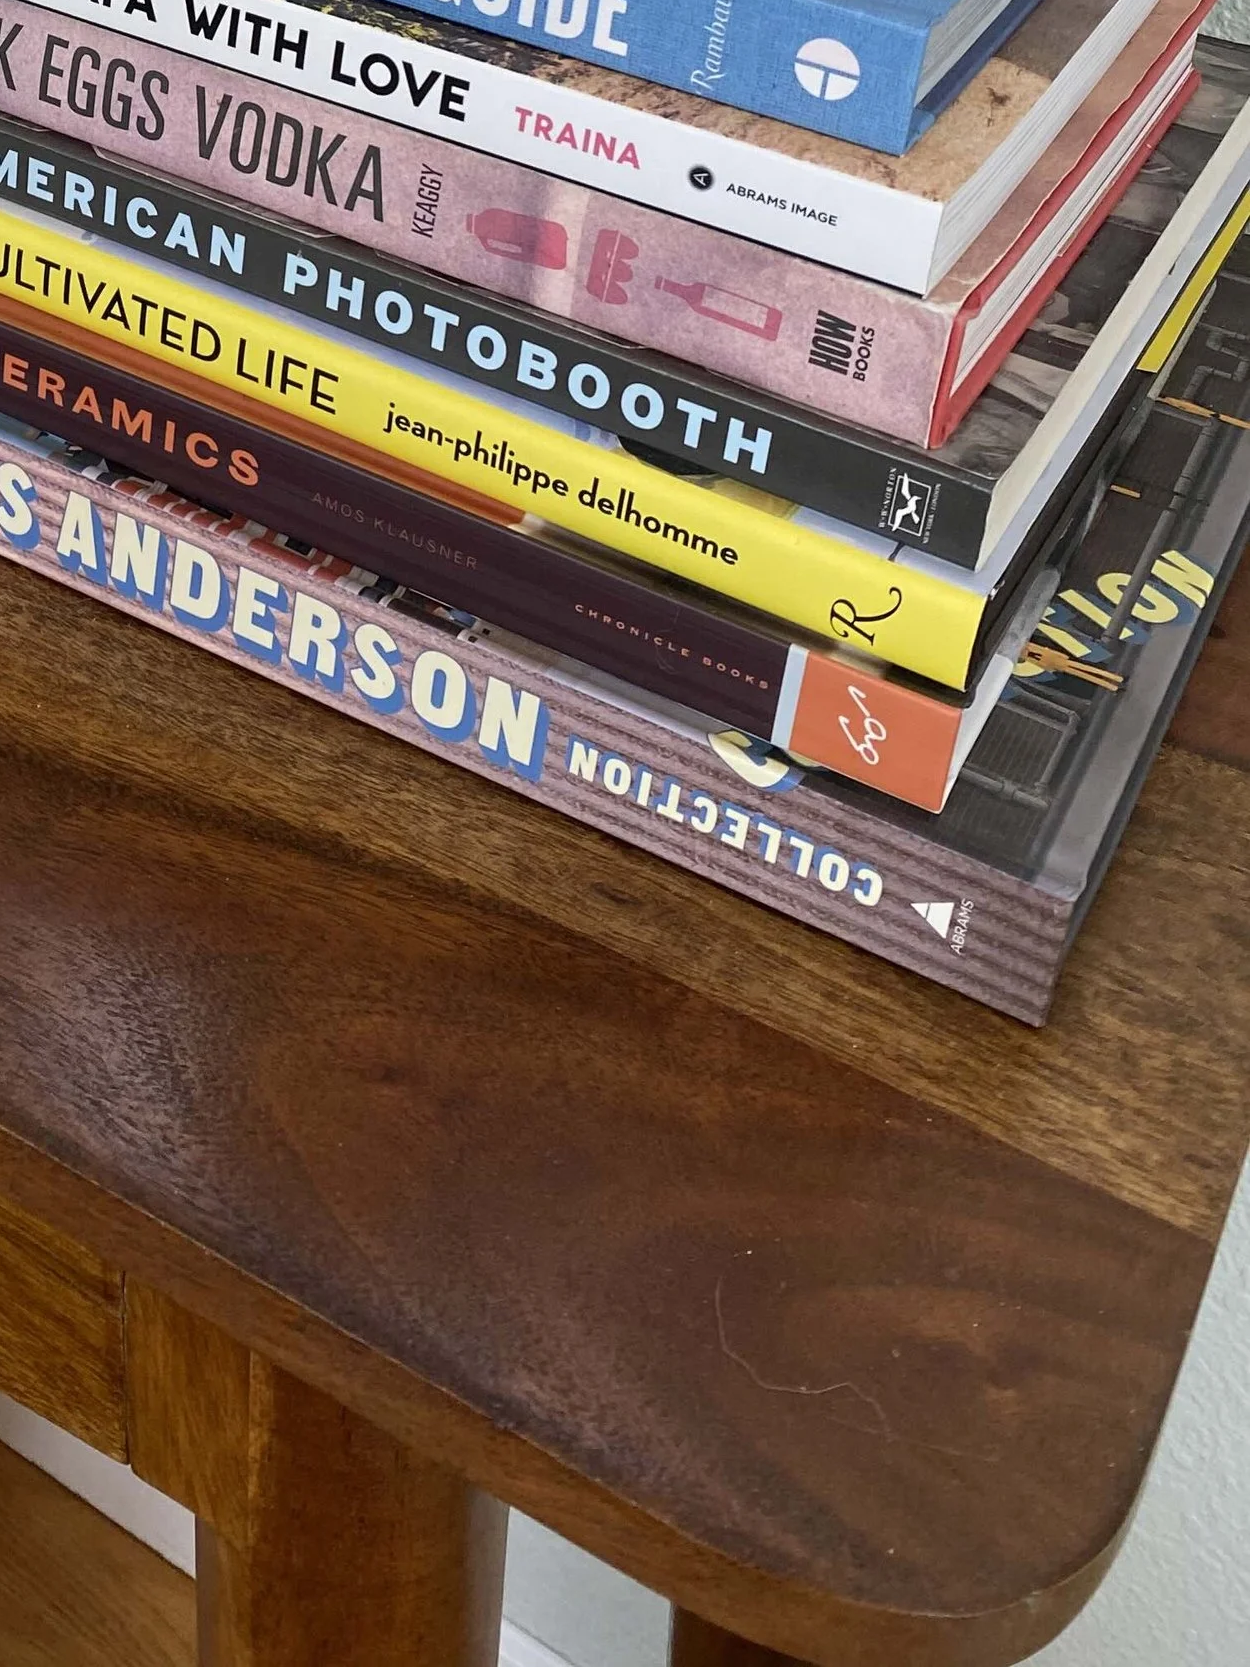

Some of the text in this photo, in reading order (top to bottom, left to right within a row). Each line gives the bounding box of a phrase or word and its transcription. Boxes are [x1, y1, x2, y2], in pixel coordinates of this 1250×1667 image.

[331, 40, 470, 121] LOVE
[39, 34, 170, 140] EGGS
[195, 84, 385, 222] VODKA
[515, 106, 640, 169] TRAINA
[411, 163, 444, 238] KEAGGY
[726, 183, 838, 227] ABRAMS IMAGE
[236, 337, 340, 415] LIFE
[283, 253, 773, 475] PHOTOBOOTH
[808, 309, 857, 375] HOW
[853, 325, 875, 382] BOOKS
[383, 402, 739, 566] jean-philippe delhomme
[312, 492, 478, 570] AMOS KLAUSNER
[575, 604, 769, 690] CHRONICLE BOOKS
[56, 490, 547, 776] ANDERSON
[568, 738, 884, 907] COLLECTION
[950, 898, 974, 955] ABRAMS
